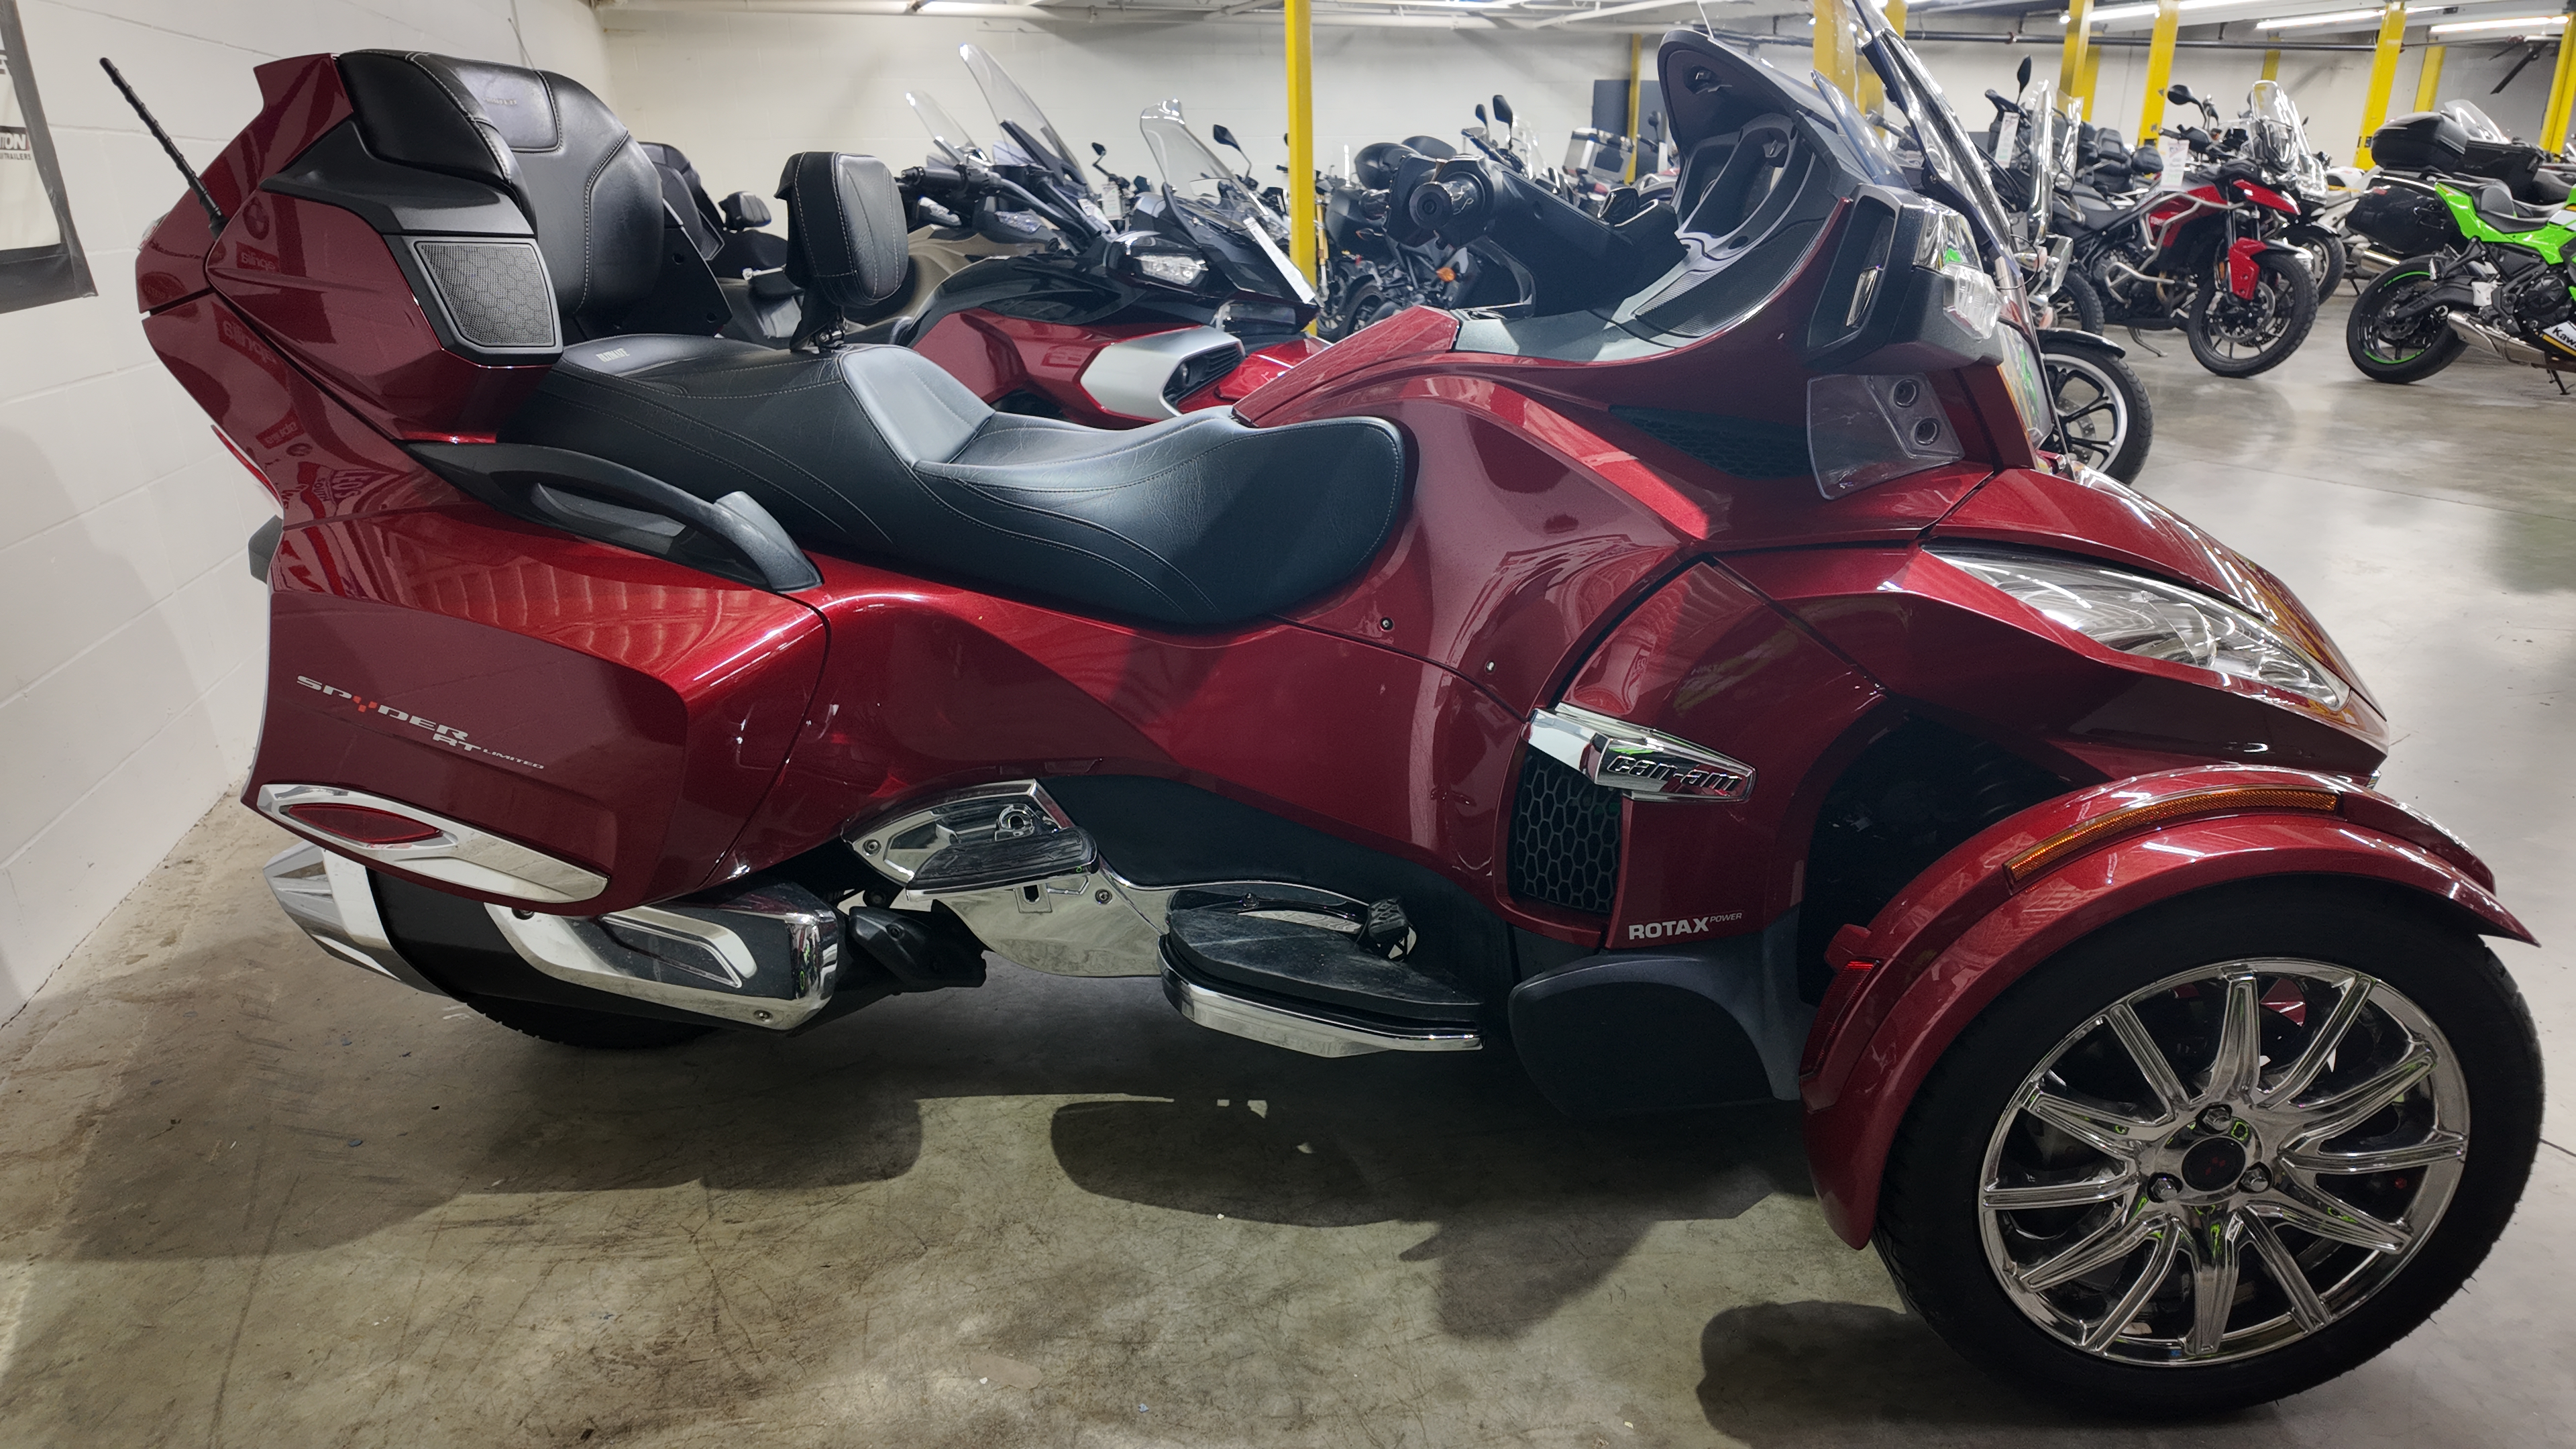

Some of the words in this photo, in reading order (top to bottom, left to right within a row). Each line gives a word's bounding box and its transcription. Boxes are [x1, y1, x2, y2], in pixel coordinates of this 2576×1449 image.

[296, 675, 469, 742] SPYDER
[433, 733, 482, 753] RT
[482, 748, 544, 770] LIMITED
[1607, 754, 1743, 792] can-am
[1628, 916, 1709, 941] ROTAX
[1709, 912, 1743, 924] POWER
